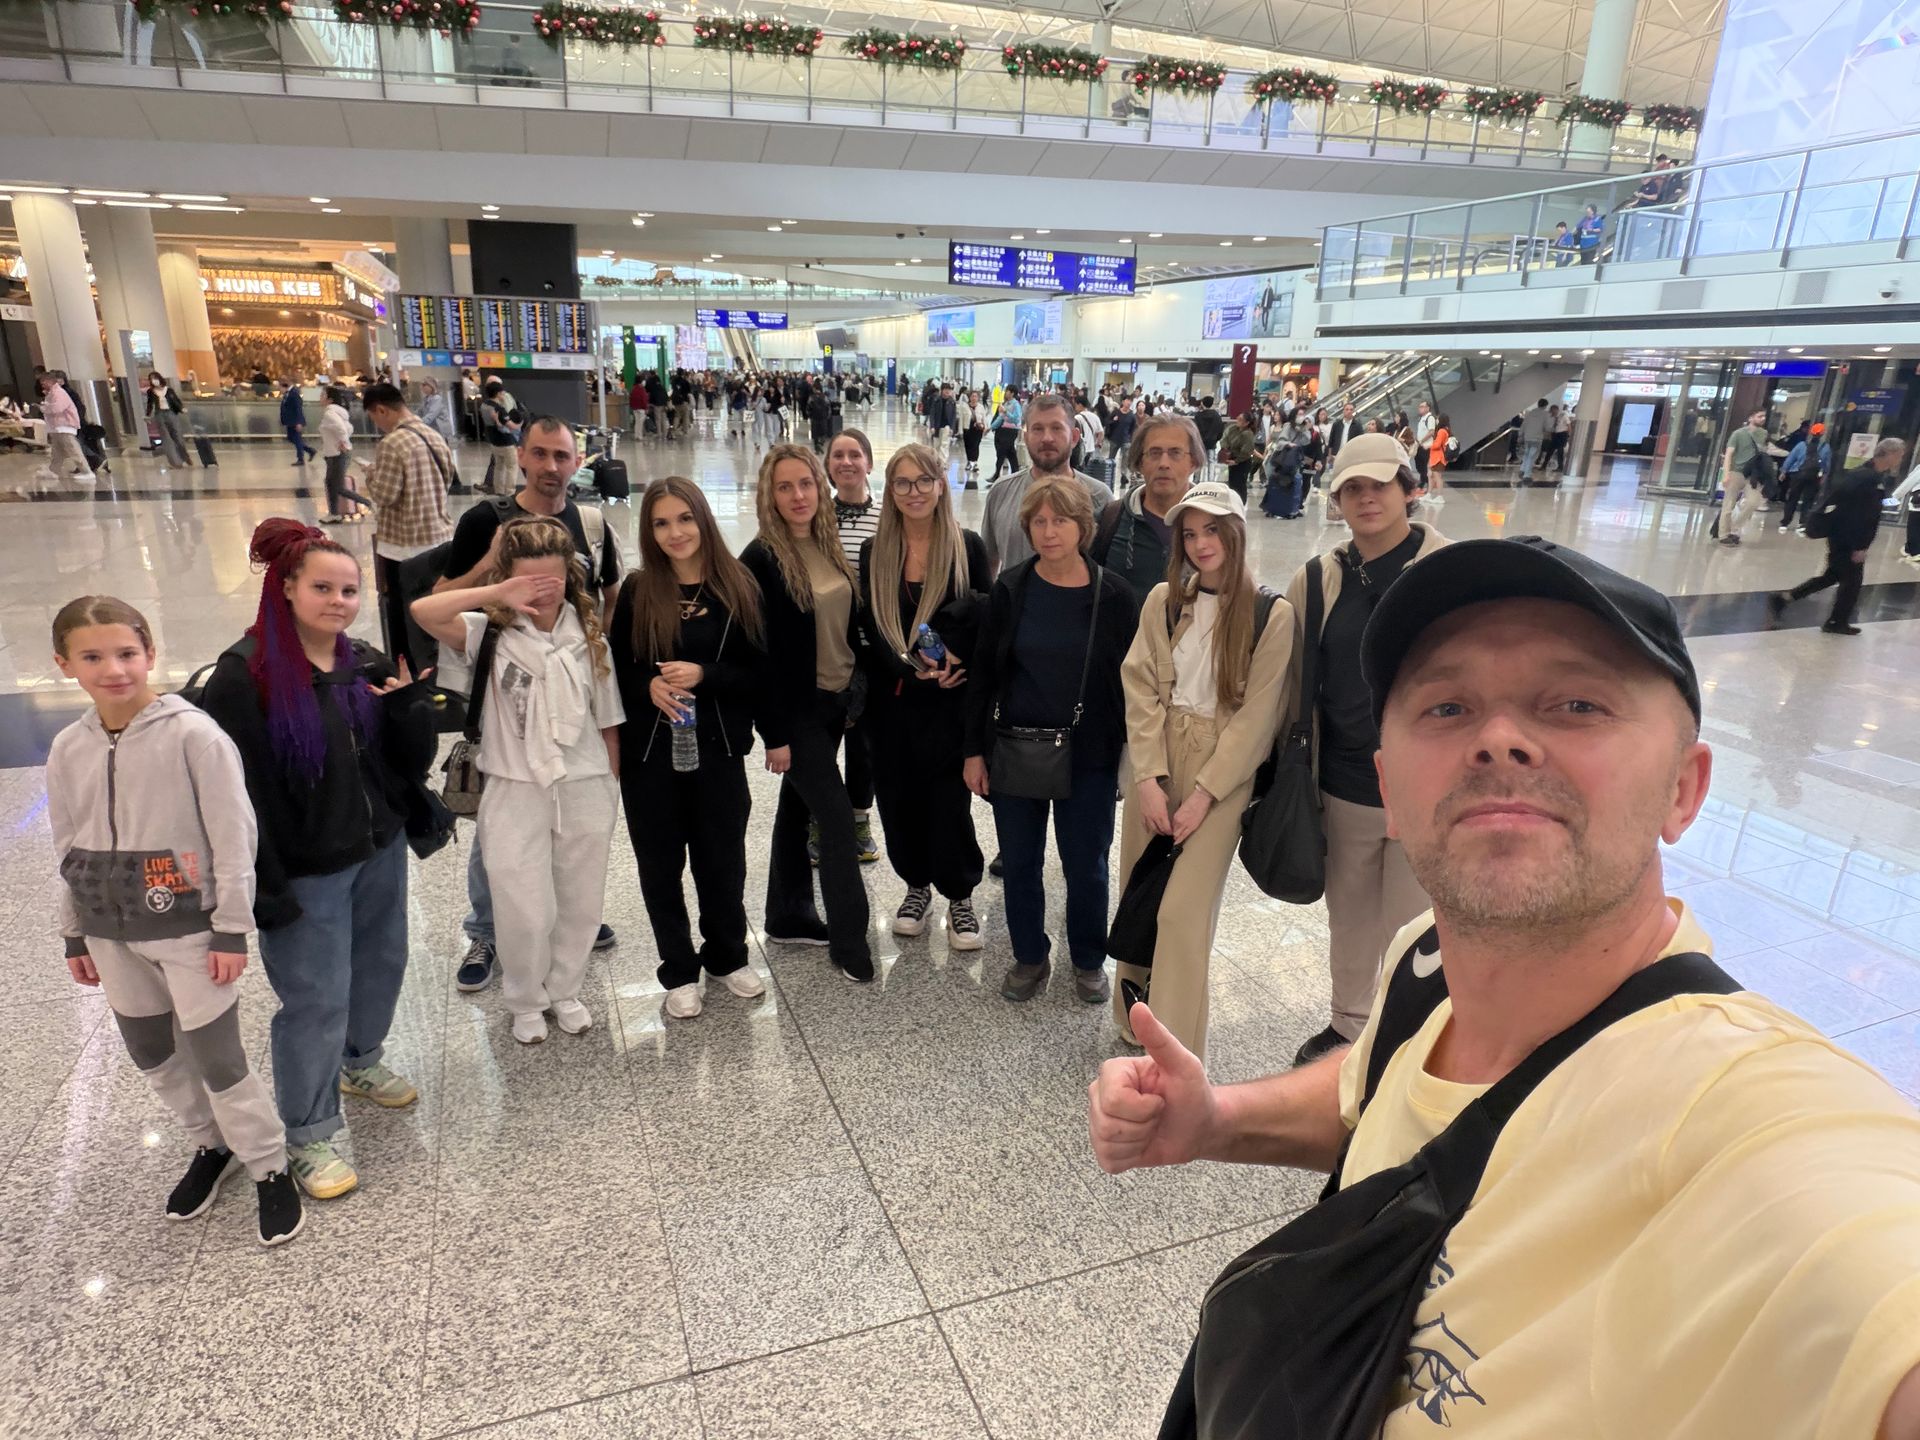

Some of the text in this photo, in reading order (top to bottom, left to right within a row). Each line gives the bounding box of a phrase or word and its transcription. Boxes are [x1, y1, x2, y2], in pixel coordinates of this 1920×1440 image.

[1047, 252, 1054, 263] B
[1050, 266, 1055, 276] 1
[216, 278, 275, 294] HUNG
[282, 281, 321, 296] KEE
[824, 345, 832, 354] B
[144, 857, 172, 872] LIVE
